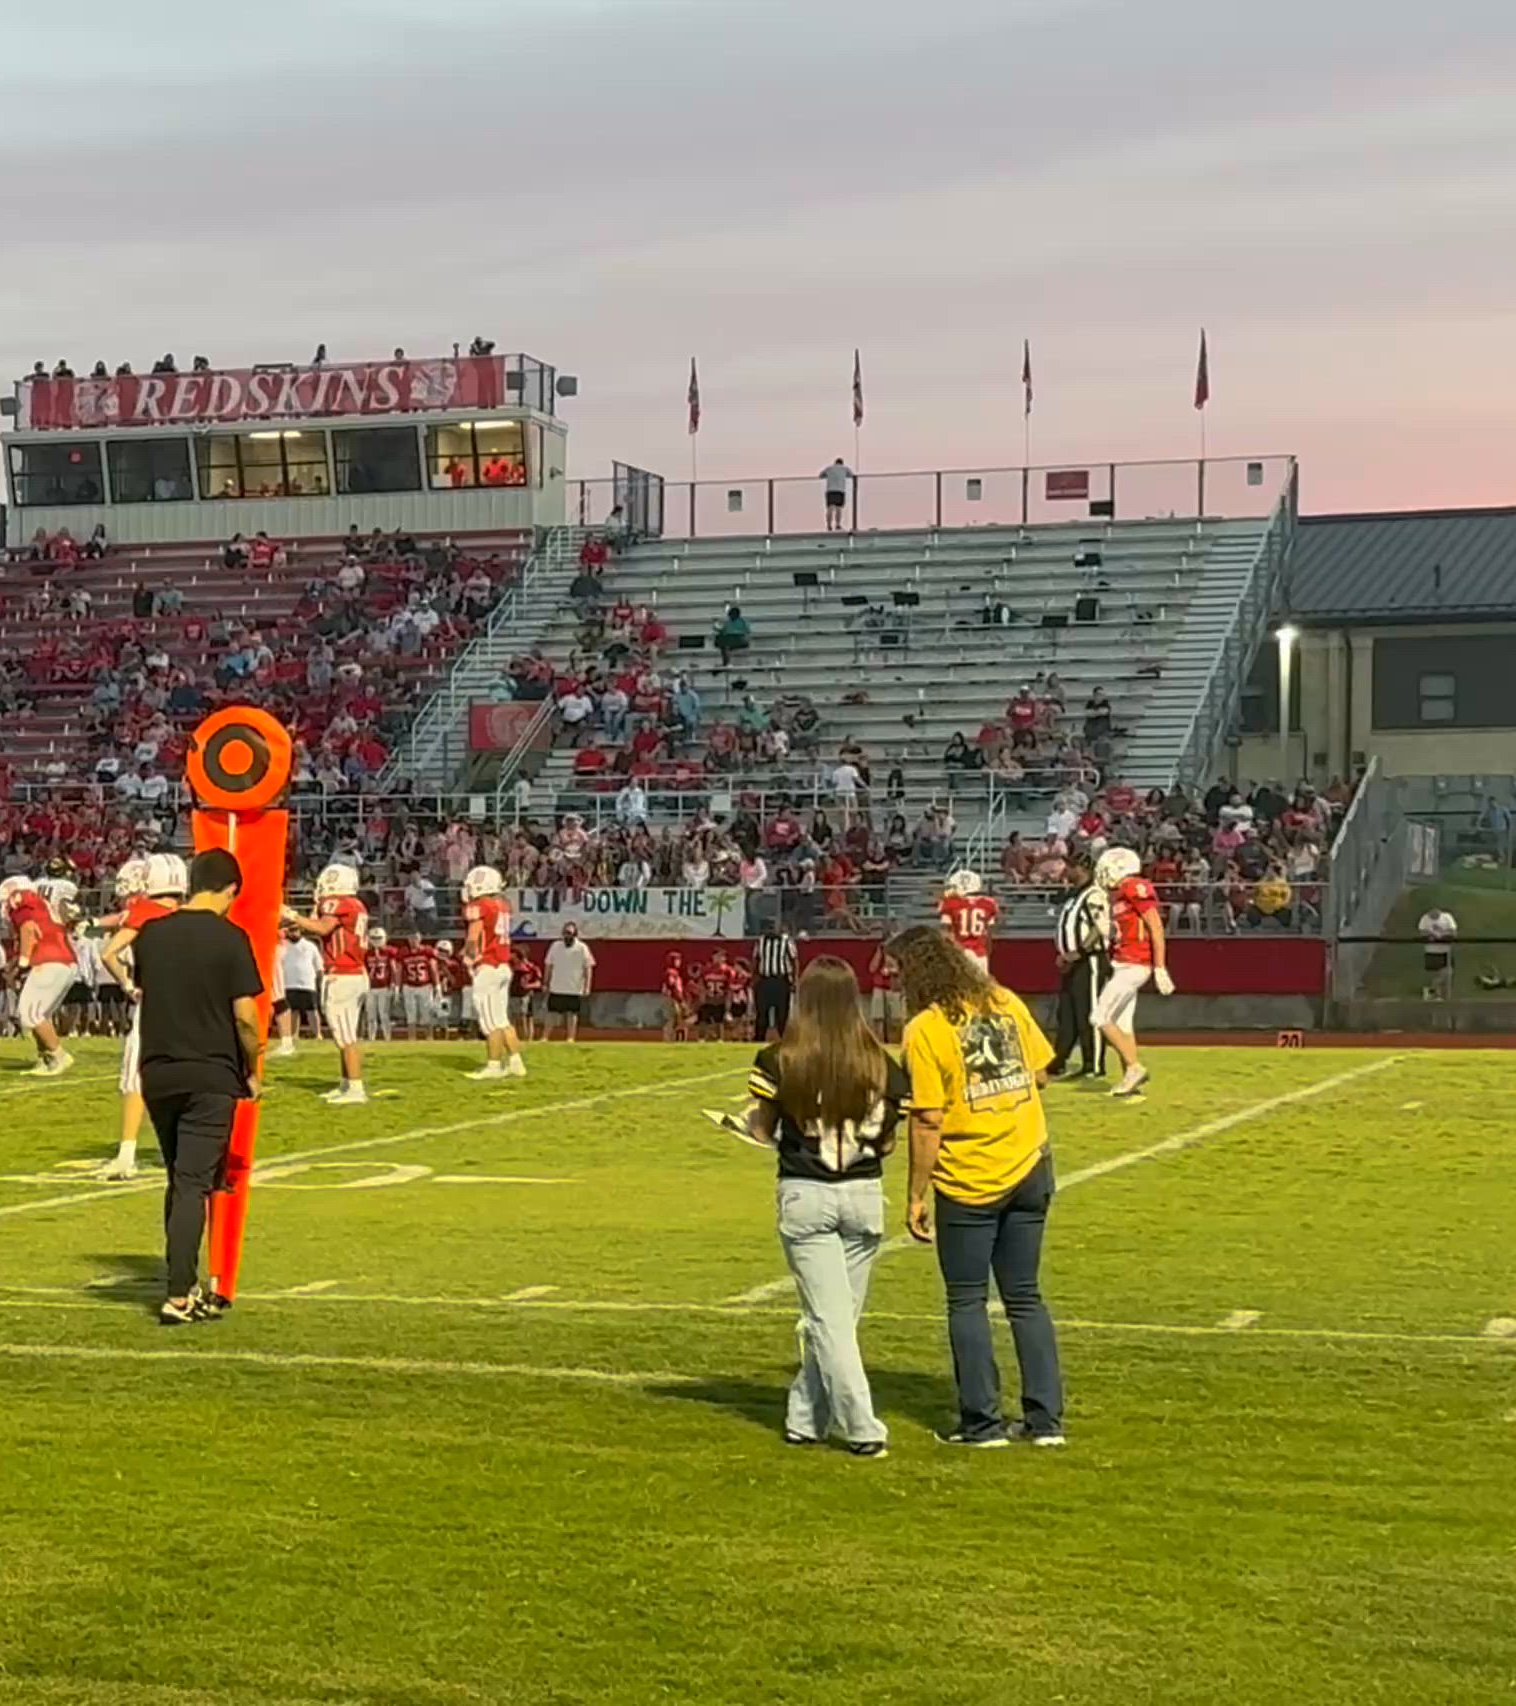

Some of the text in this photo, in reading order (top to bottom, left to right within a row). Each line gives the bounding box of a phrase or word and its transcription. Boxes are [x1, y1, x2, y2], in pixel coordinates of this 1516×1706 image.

[134, 366, 405, 419] REDSKINS
[583, 888, 648, 914] DOWN
[663, 889, 707, 916] THE
[959, 908, 985, 936] 16
[407, 963, 428, 982] 55
